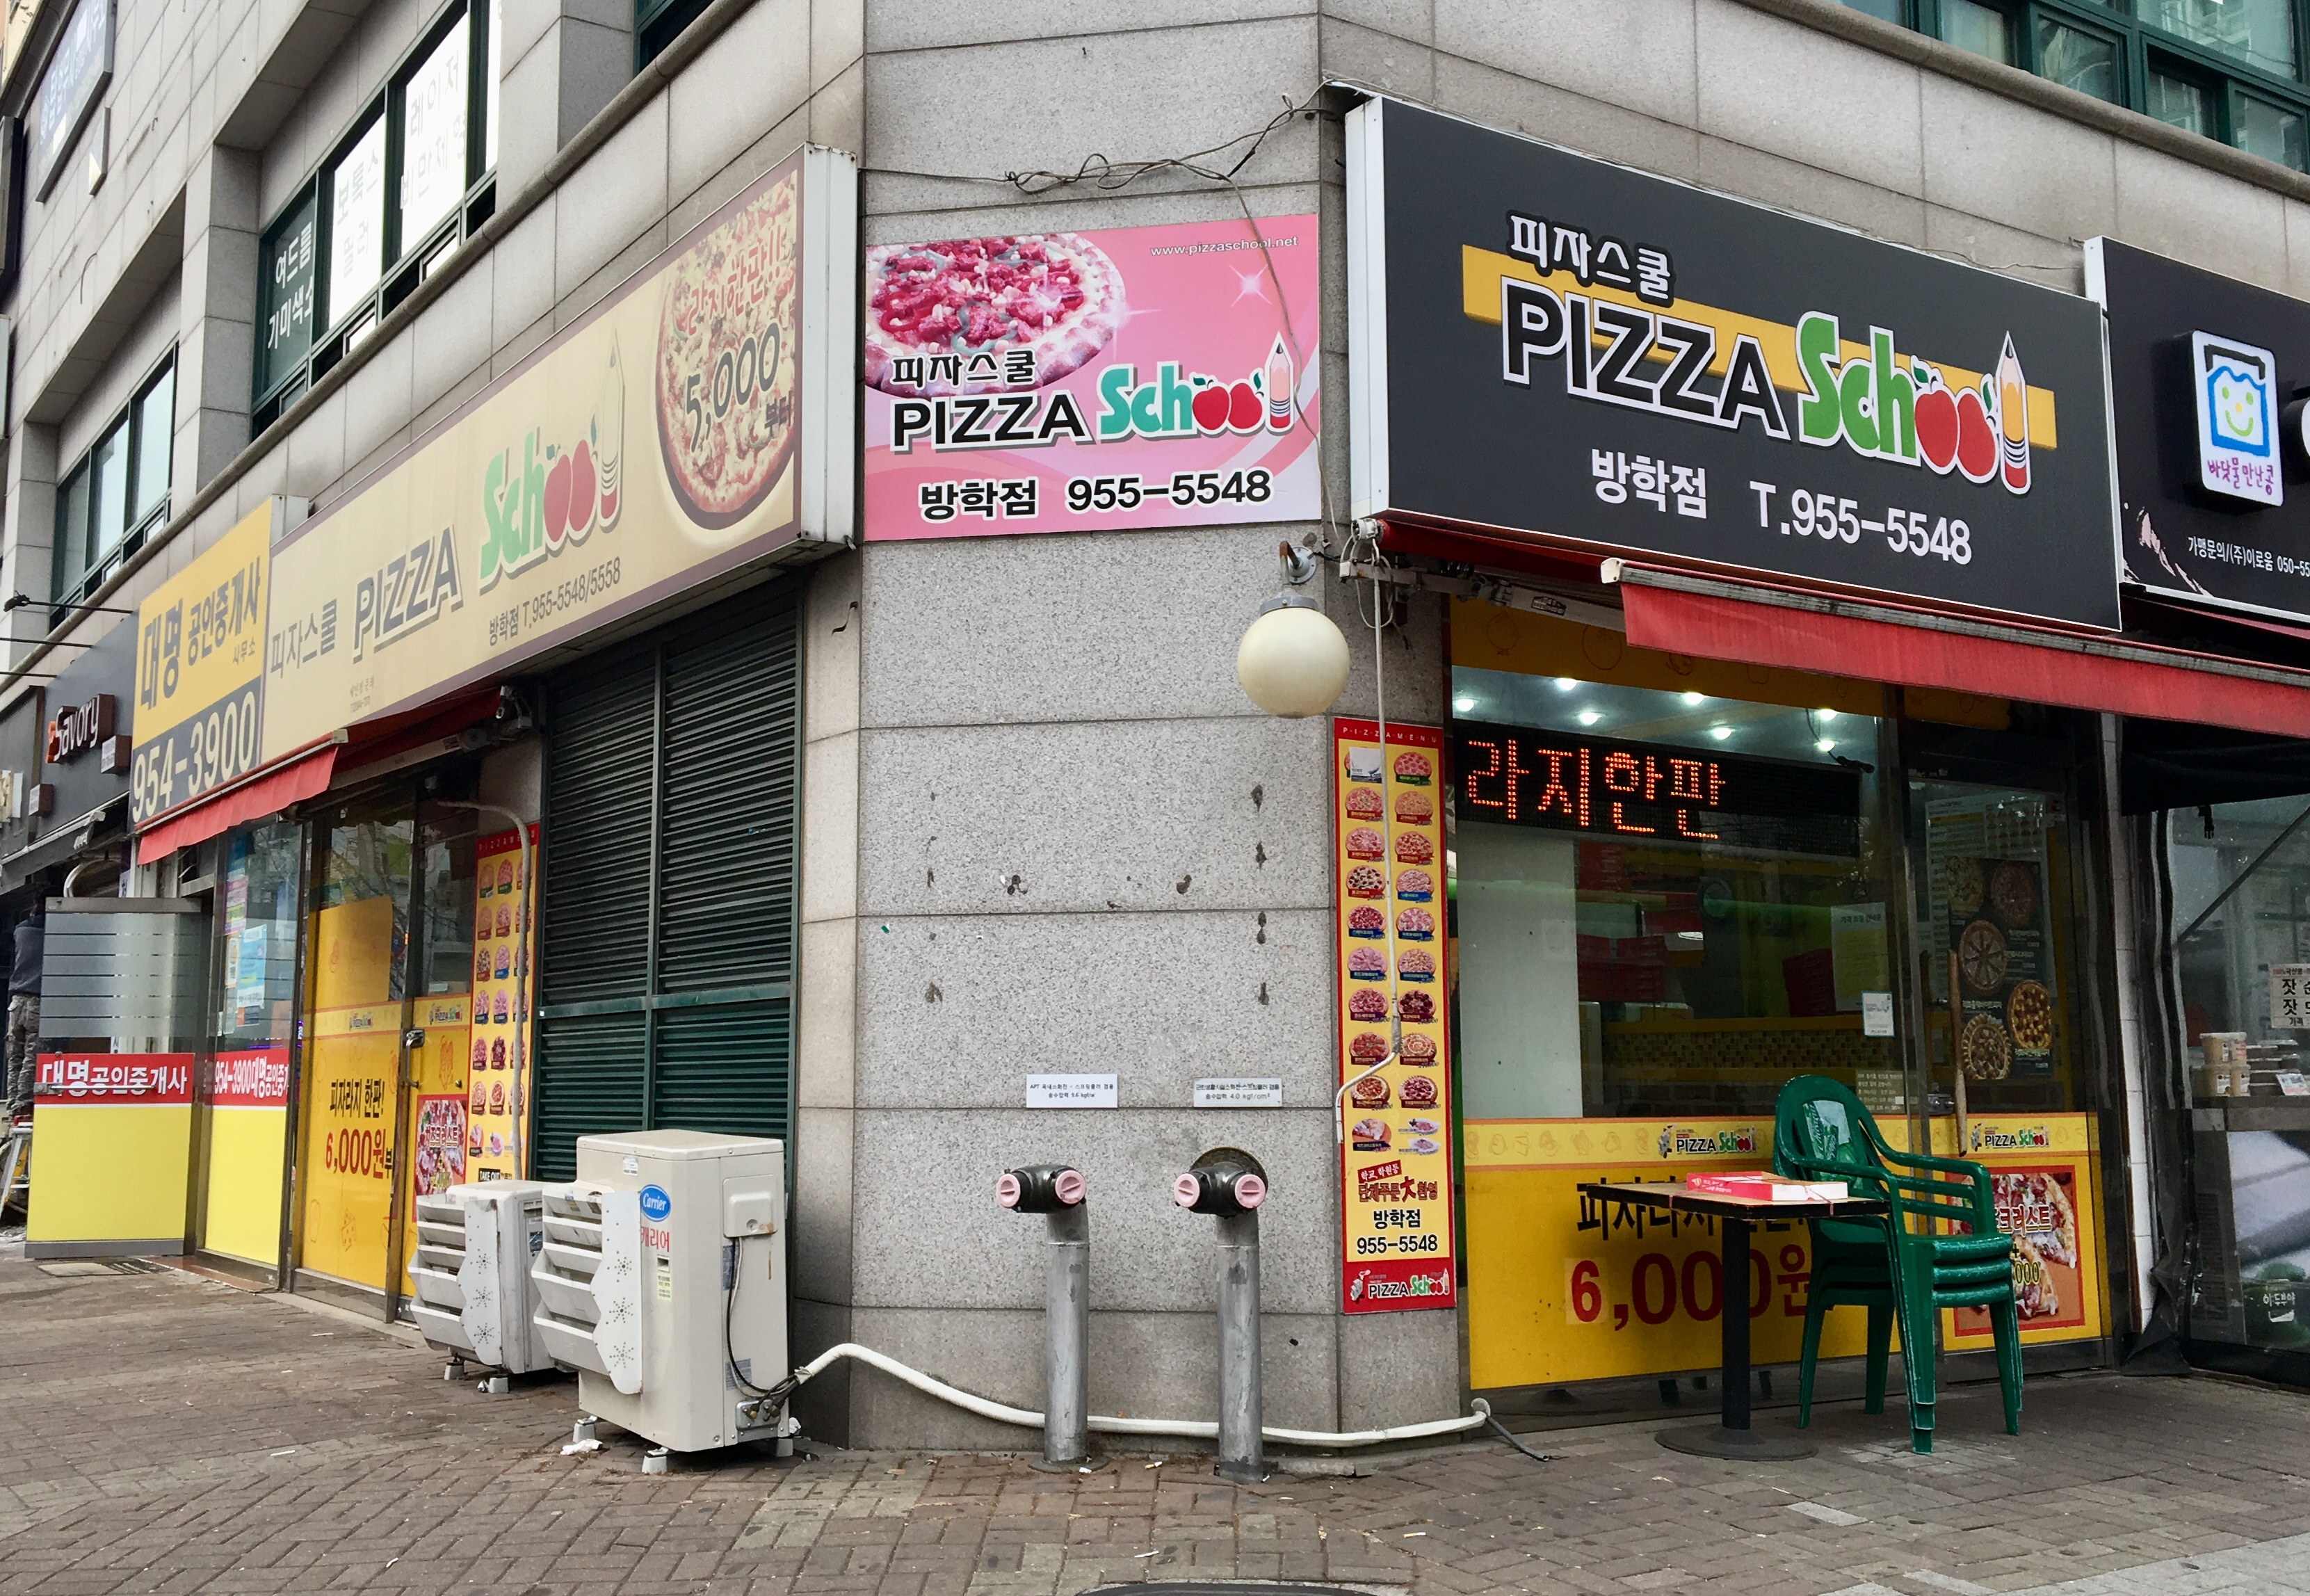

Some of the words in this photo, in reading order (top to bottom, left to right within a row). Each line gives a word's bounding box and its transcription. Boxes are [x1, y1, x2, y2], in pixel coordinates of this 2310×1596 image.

[410, 49, 459, 137] 레이저
[337, 149, 379, 225] 보톡스
[275, 221, 312, 289] 여드름
[1150, 236, 1298, 257] www.pizzaschool.net
[1510, 214, 1670, 300] 피자스쿨
[686, 321, 781, 453] 5,000
[891, 392, 1089, 448] PIZZA
[1098, 332, 1293, 440] School
[892, 350, 1036, 387] 피자스쿨
[1502, 276, 1791, 441] PIZZA
[1795, 311, 2030, 494] School
[764, 390, 792, 438] 부터
[270, 598, 337, 679] 피자스쿨
[353, 526, 460, 655] PIZZA
[480, 328, 624, 584] School
[920, 478, 1037, 519] 방학점
[1067, 470, 1271, 511] 955-5548
[1591, 448, 1707, 520] 방학점
[140, 597, 184, 710] 대명
[188, 556, 261, 666] 공인중개사
[489, 604, 519, 646] 방학점
[232, 636, 256, 666] 사무소
[54, 695, 100, 761] Savory
[132, 691, 256, 823] 954-3900
[42, 1059, 188, 1097] 대명공인중개사
[330, 1078, 362, 1118] 피자라지
[364, 1078, 385, 1118] 한판!
[1676, 1138, 1717, 1153] PIZZA
[1985, 1134, 2017, 1148] PIZZA
[643, 1193, 667, 1211] Carrier
[1373, 1209, 1421, 1230] 방학점
[640, 1225, 670, 1252] 캐리어
[1357, 1234, 1438, 1255] 955-5548
[1368, 1282, 1410, 1299] PIZZA
